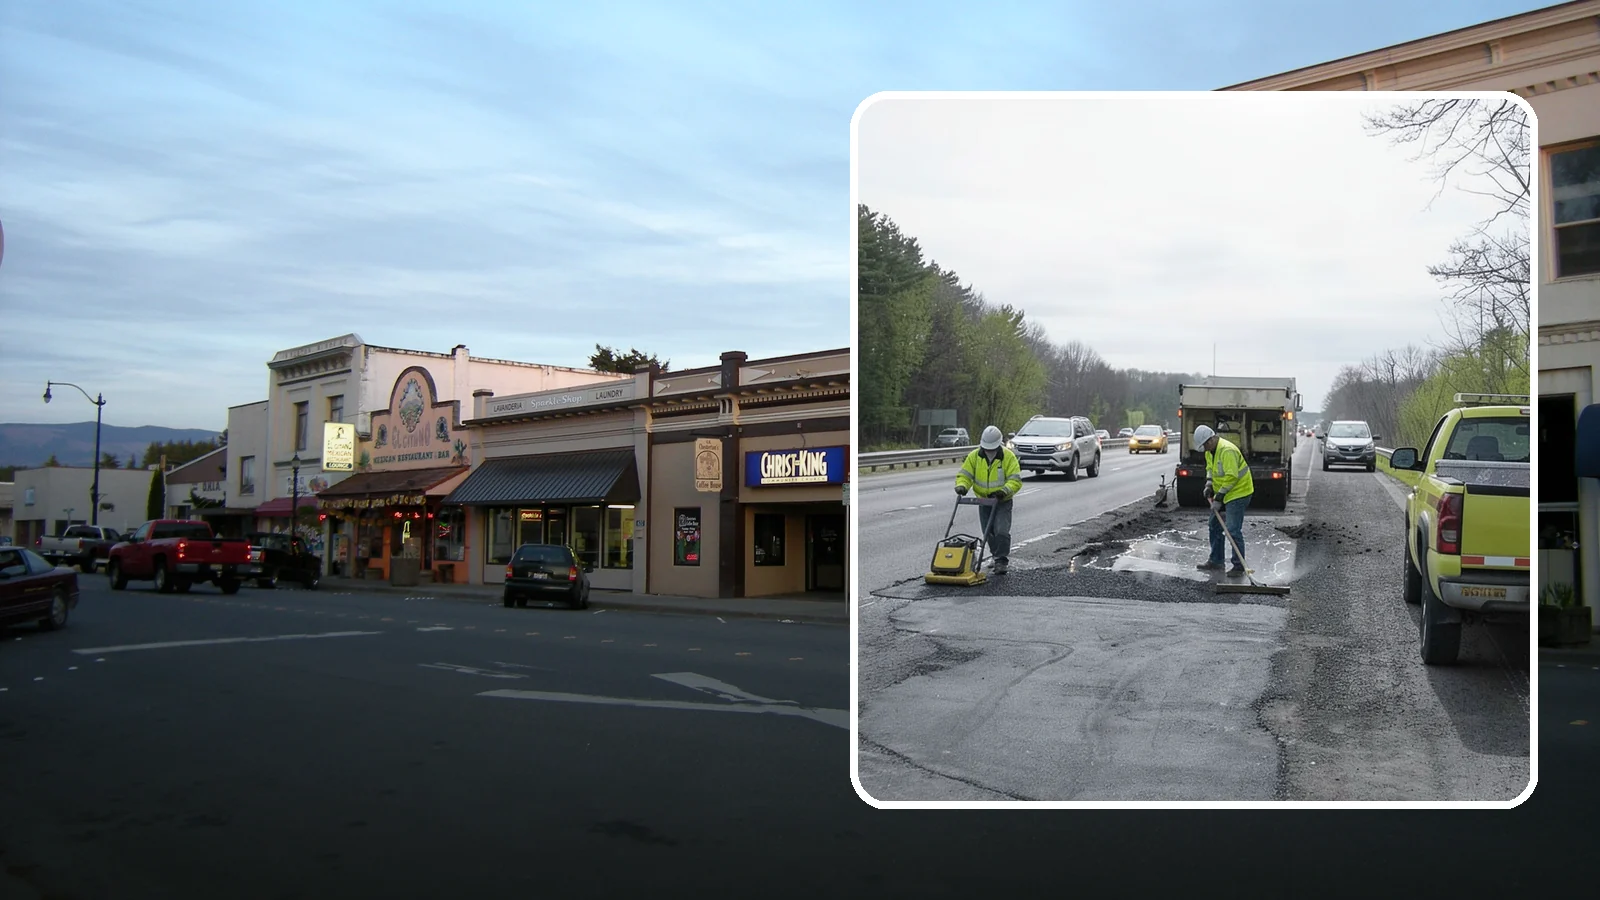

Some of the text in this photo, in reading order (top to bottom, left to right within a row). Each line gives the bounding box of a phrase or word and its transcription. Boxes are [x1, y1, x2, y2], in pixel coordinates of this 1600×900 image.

[493, 402, 522, 412] LAVANDERIA
[562, 394, 582, 405] Shop
[595, 388, 623, 400] LAUNDRY
[373, 455, 396, 464] MEXICAN
[397, 451, 433, 462] RESTAURANT
[438, 450, 449, 459] BAR
[761, 450, 827, 477] CHRIST KING
[696, 480, 709, 488] Coffee
